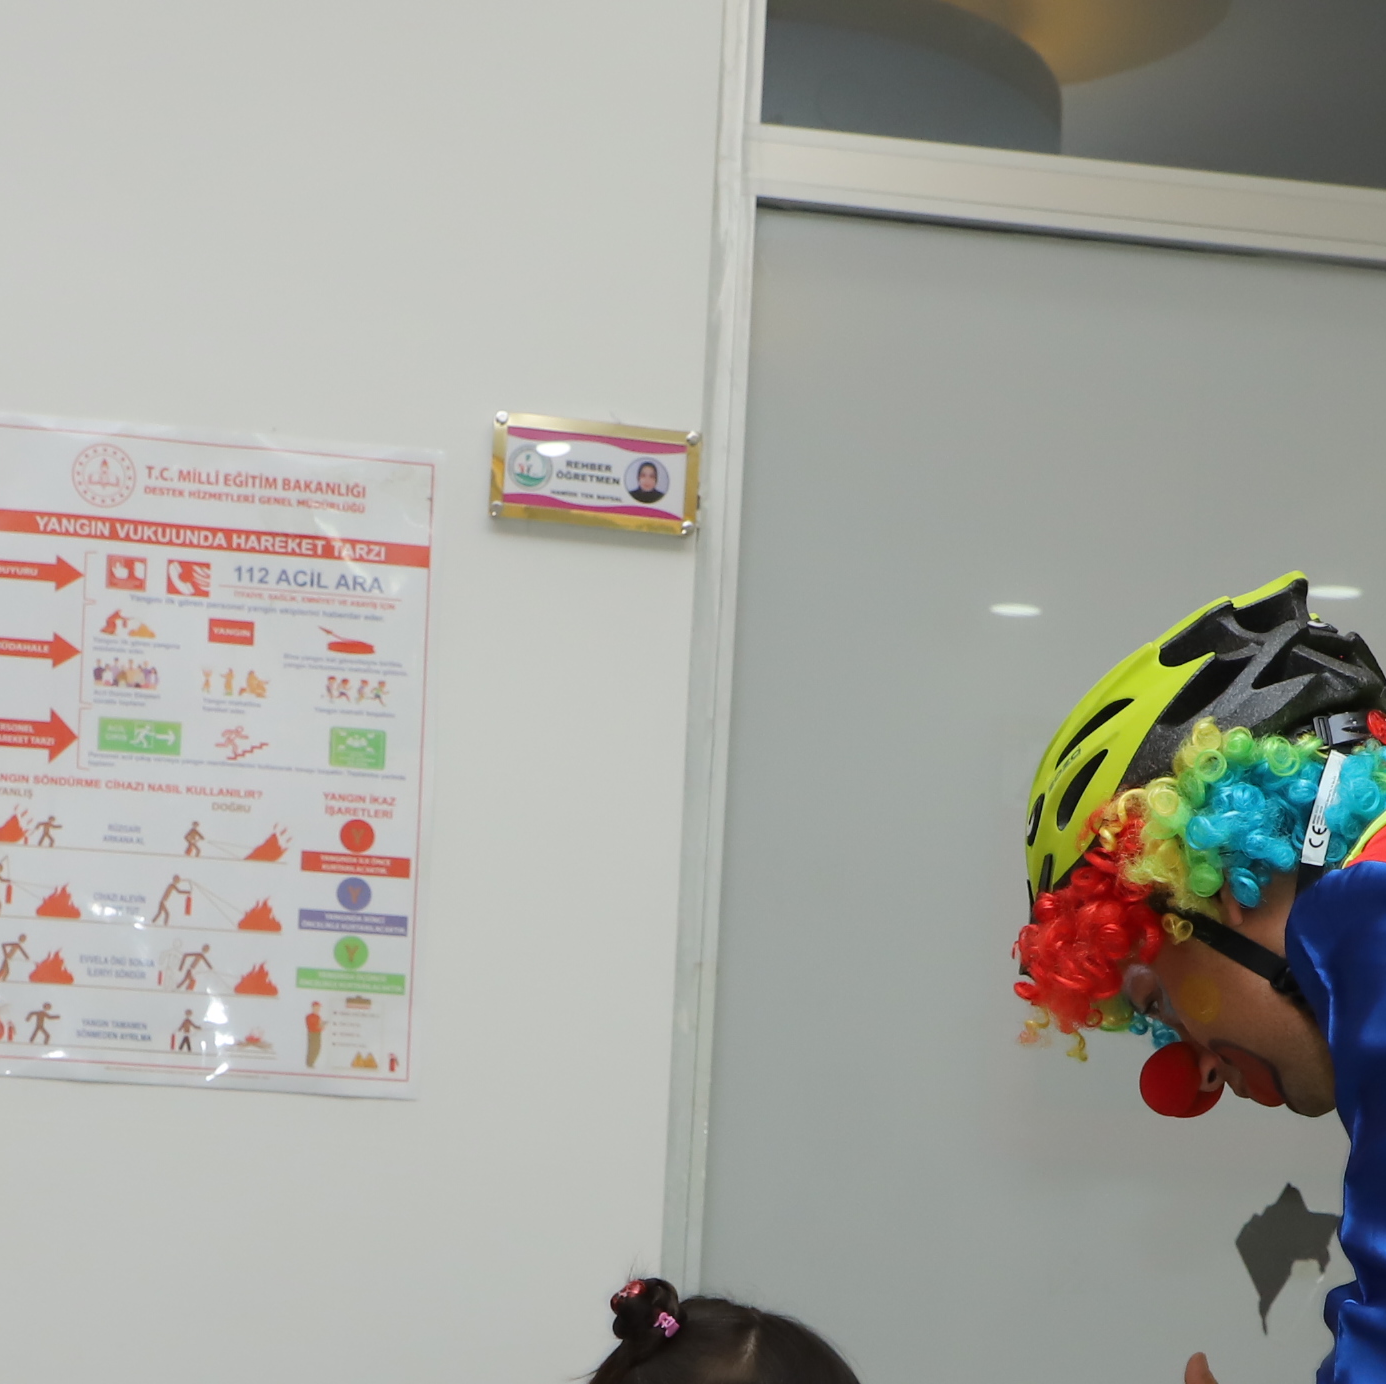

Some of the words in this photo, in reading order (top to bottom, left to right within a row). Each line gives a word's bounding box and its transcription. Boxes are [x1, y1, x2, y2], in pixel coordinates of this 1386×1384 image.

[565, 460, 612, 473] REHBER
[146, 466, 173, 482] T.C.
[177, 467, 220, 486] MİLLİ
[224, 471, 277, 490] EĞİTİM
[282, 477, 366, 498] BAKANLIĞI
[556, 469, 621, 486] ÖĞRETMEN
[144, 486, 185, 498] DESTEK
[188, 489, 256, 504] HİZMETLERİ
[259, 495, 293, 508] GENEL
[35, 515, 111, 537] YANGIN
[115, 521, 227, 548] VUKUUNDA
[231, 532, 325, 556] HAREKET
[331, 541, 386, 561] TARZI
[234, 565, 269, 584] 112
[276, 568, 328, 589] ACİL
[335, 573, 384, 594] ARA
[213, 627, 251, 638] YANGIN
[33, 774, 101, 790] SÖNDÜRME
[105, 778, 144, 793] CİHAZI
[148, 782, 183, 796] NASIL
[186, 786, 263, 800] KULLANILIR?
[212, 801, 251, 814] DOĞRU
[323, 791, 366, 804] YANGIN
[369, 793, 396, 807] İKAZ
[325, 805, 393, 819] İŞARETLERİ
